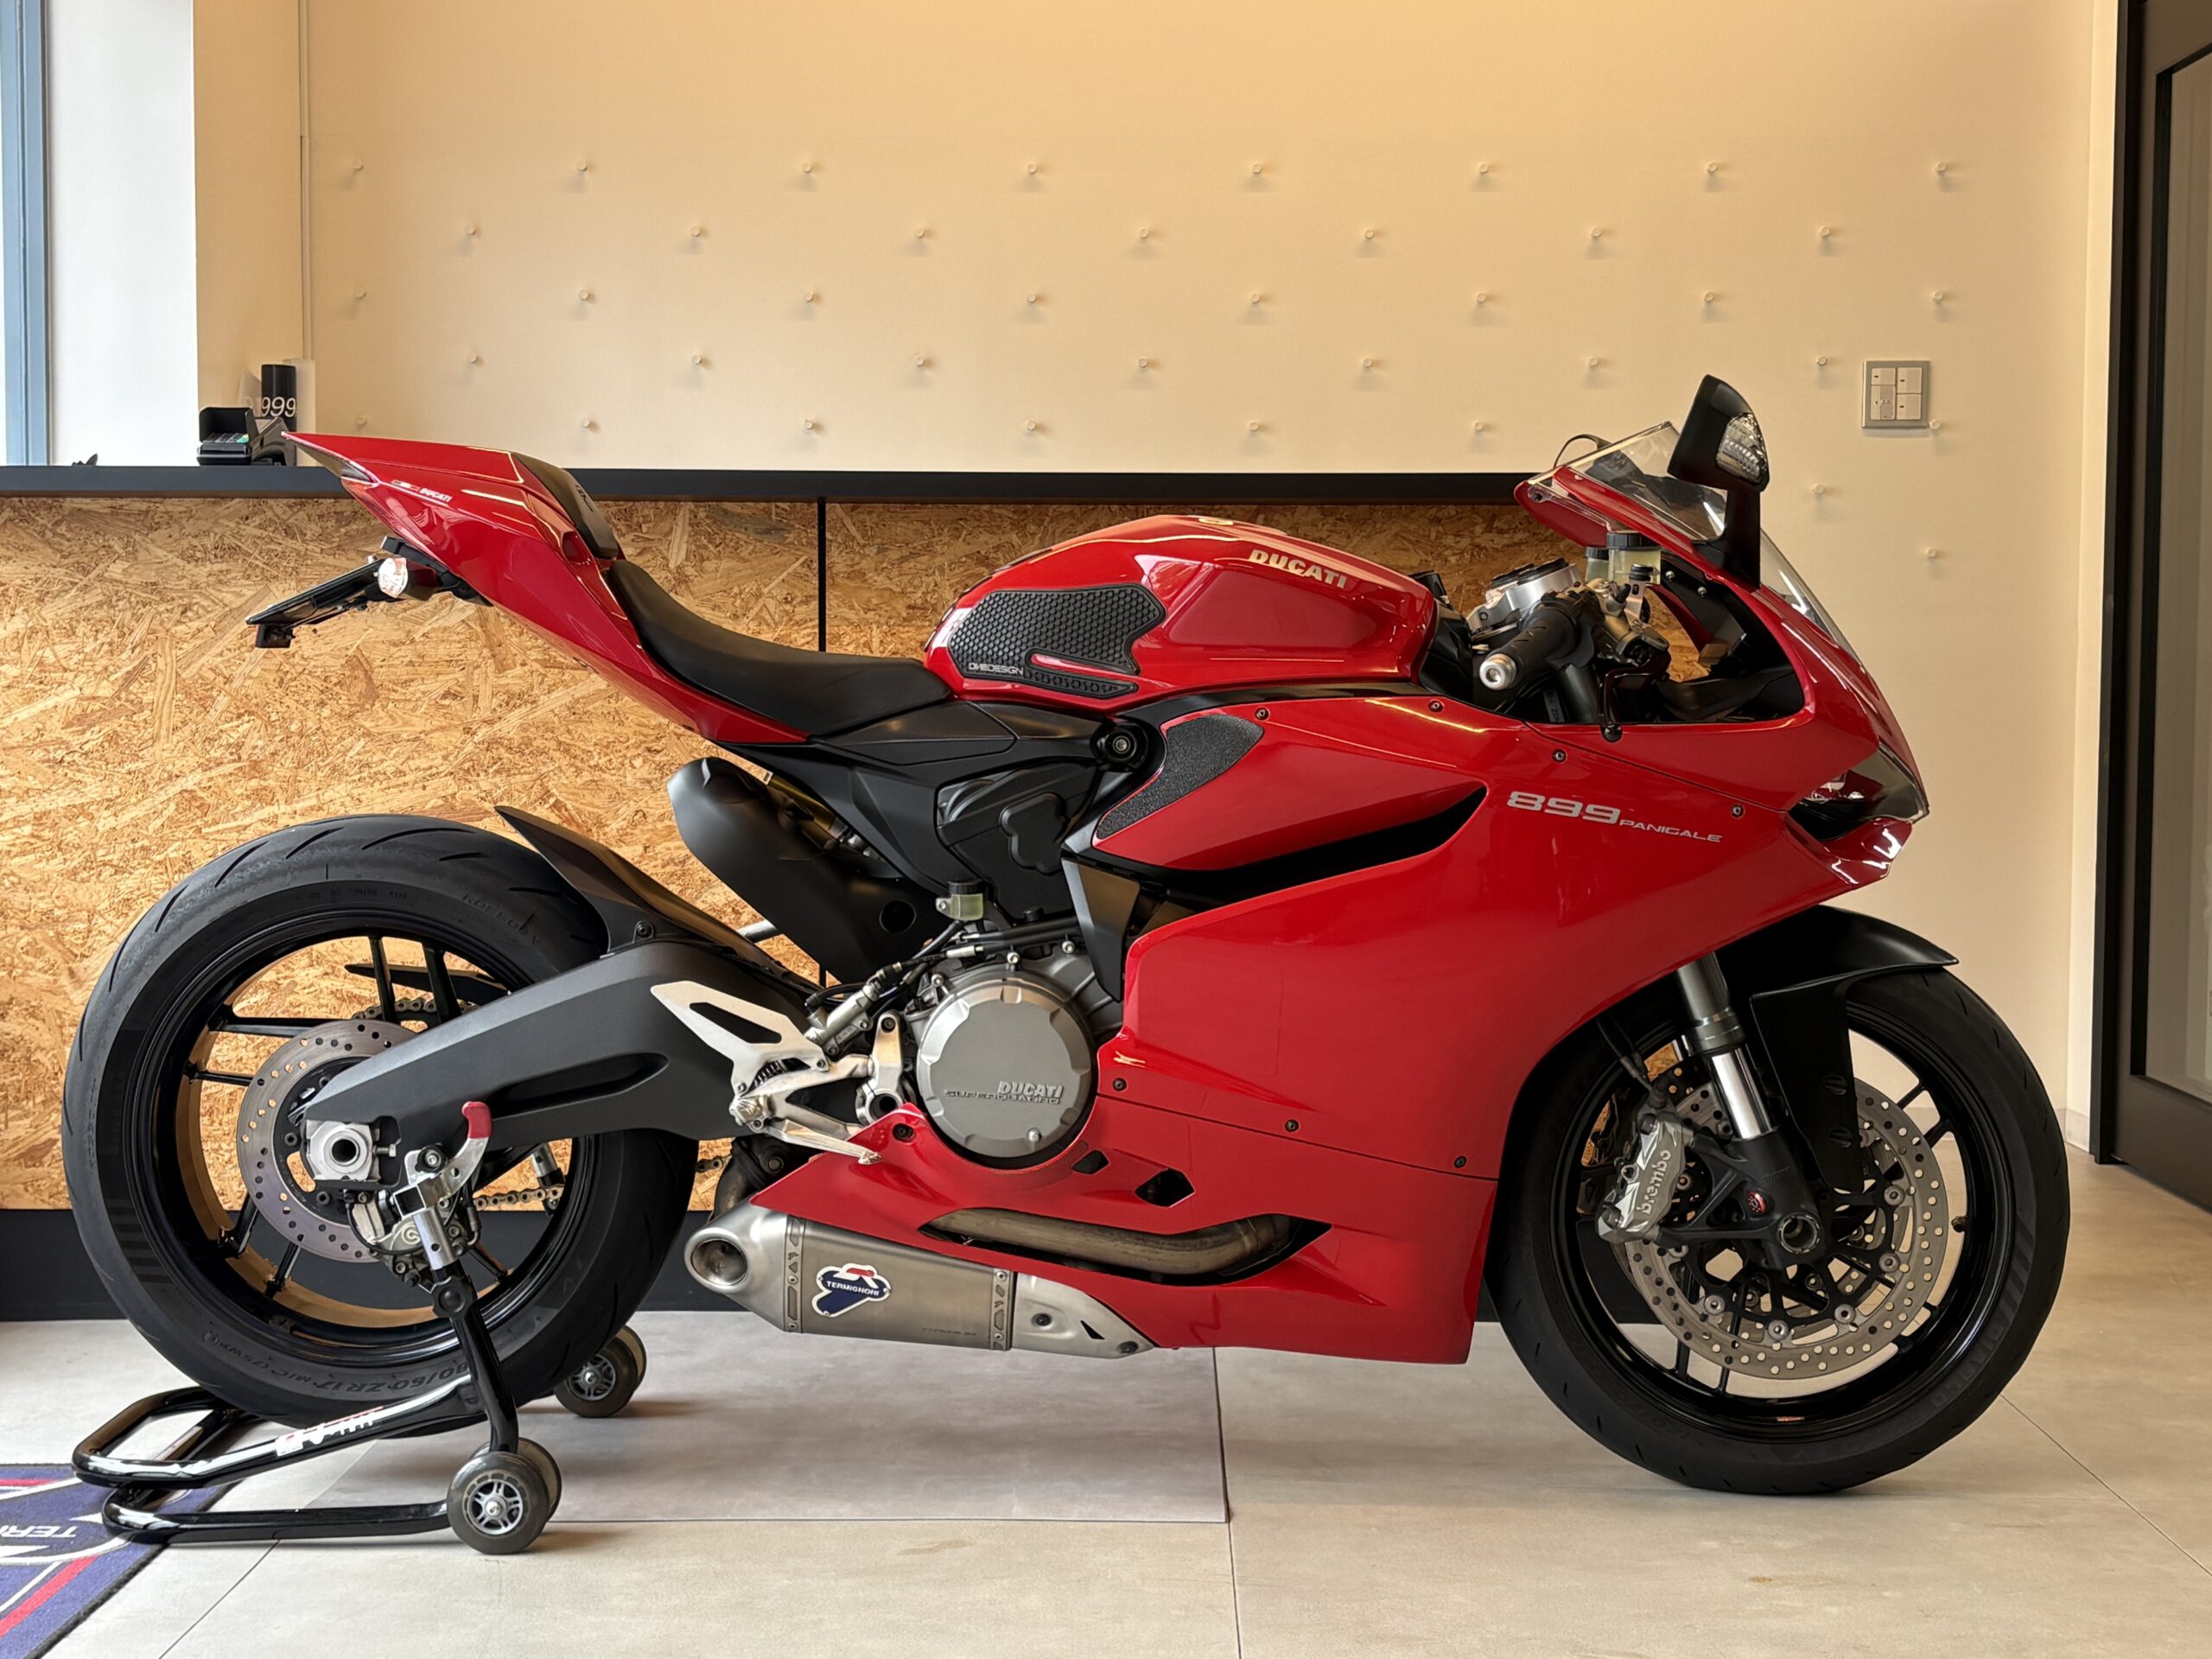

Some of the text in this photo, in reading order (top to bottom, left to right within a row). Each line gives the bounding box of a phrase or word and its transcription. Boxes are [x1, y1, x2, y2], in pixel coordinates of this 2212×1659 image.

[420, 487, 454, 502] DUCATI
[1249, 549, 1348, 589] DUCATI
[1507, 791, 1723, 843] 899 PANIGALE
[997, 1080, 1064, 1098] DUCATI
[1640, 1148, 1671, 1216] brembo
[826, 1280, 880, 1296] TERMIGNONI
[393, 1362, 468, 1391] 80/60
[0, 1524, 79, 1538] TER
